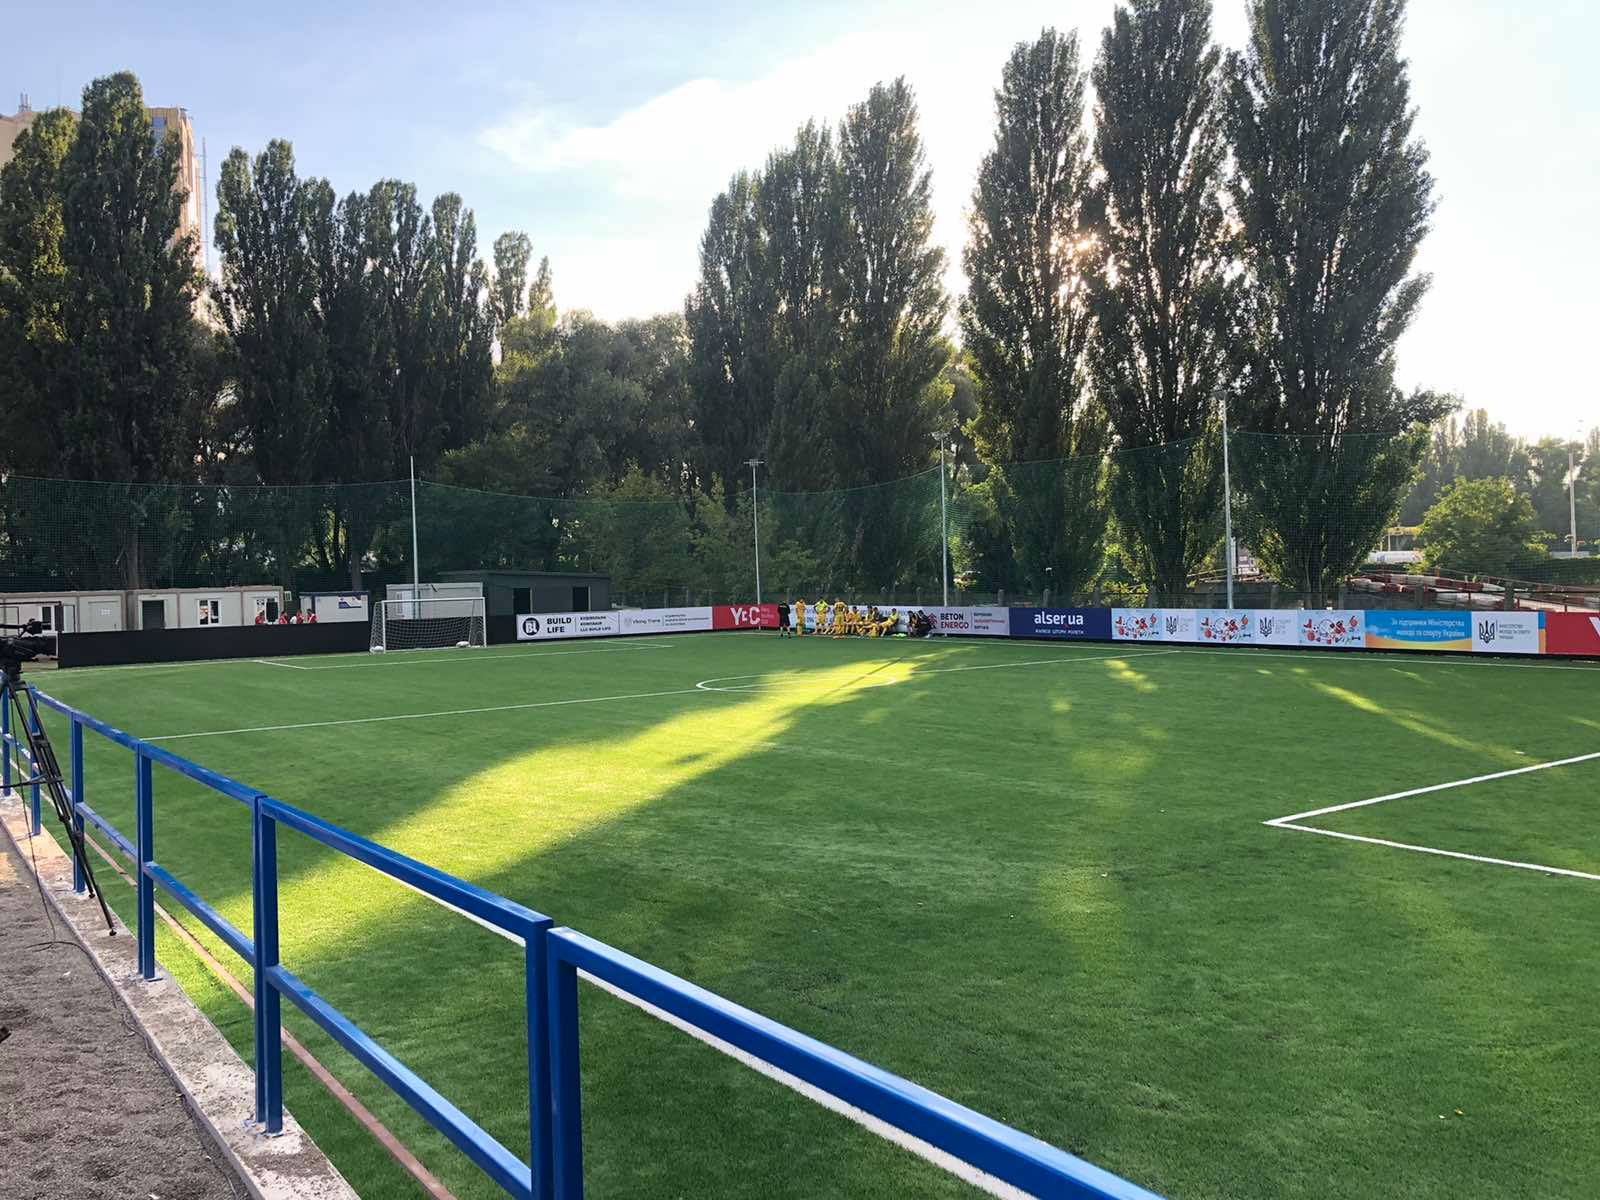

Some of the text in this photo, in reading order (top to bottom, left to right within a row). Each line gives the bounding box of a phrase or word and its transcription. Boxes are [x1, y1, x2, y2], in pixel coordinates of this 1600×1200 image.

[940, 612, 964, 620] BETON
[546, 617, 572, 625] BUILD
[940, 621, 970, 629] ENERGO
